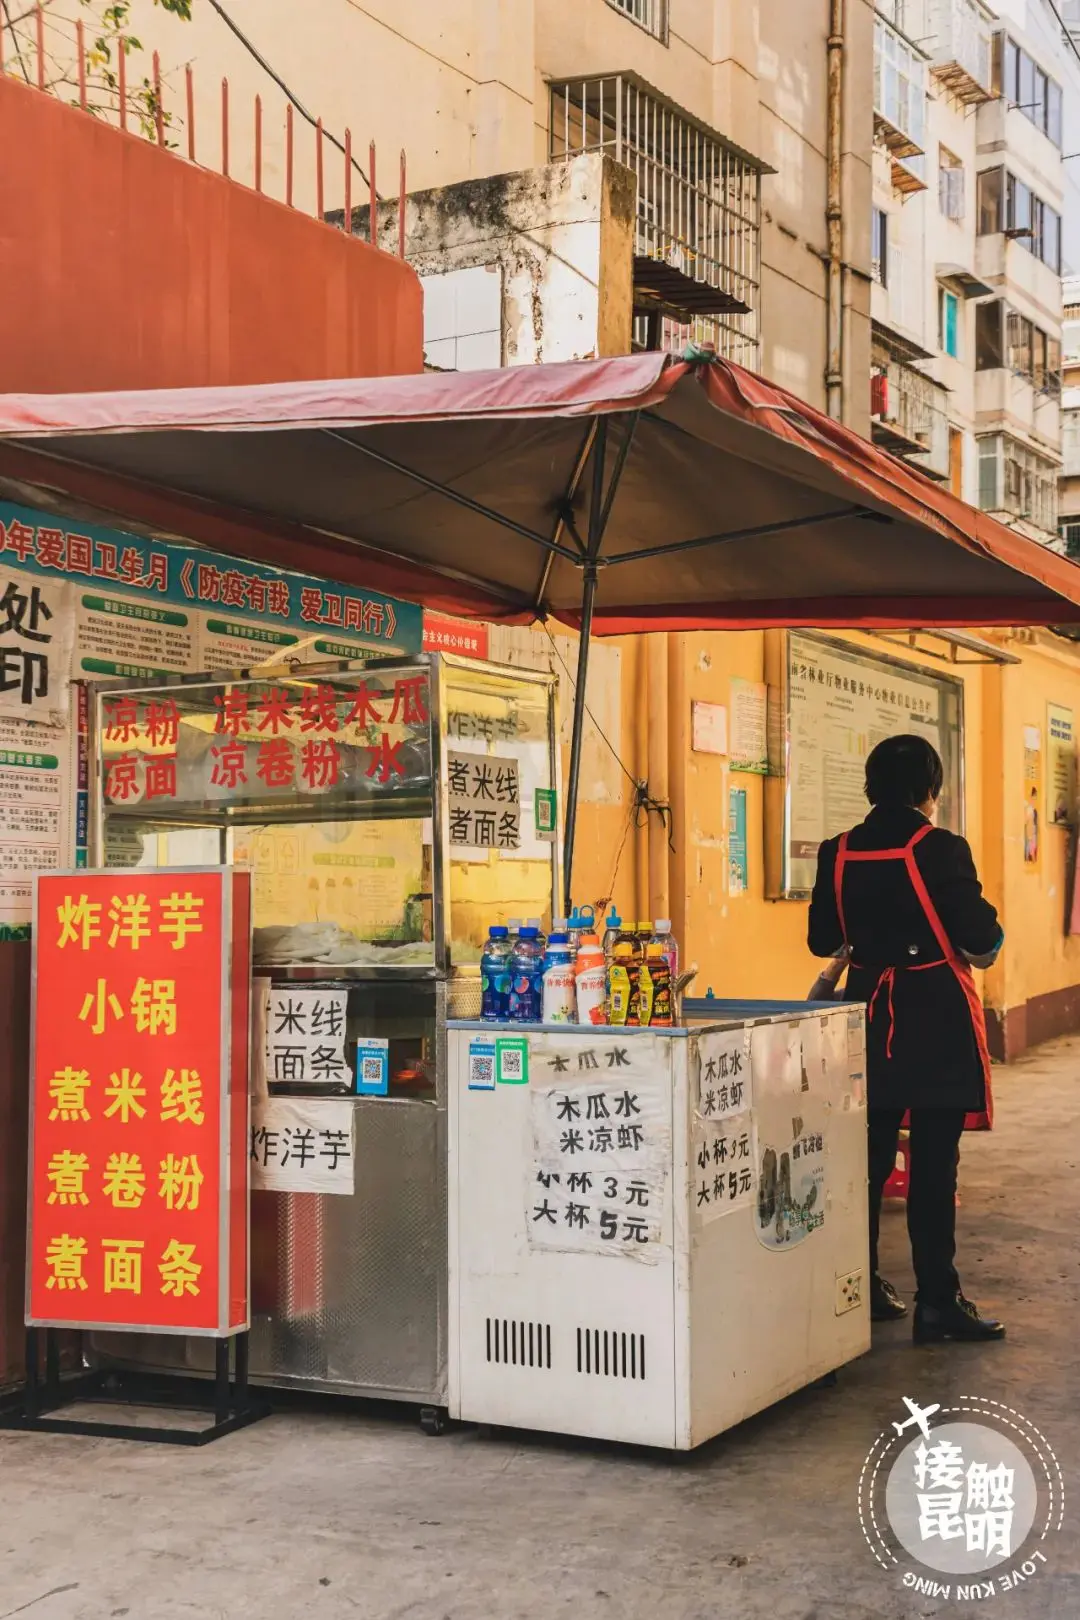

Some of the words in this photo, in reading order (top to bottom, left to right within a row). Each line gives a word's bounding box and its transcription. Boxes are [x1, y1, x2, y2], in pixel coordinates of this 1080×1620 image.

[0, 647, 49, 704] 印
[104, 696, 180, 747] 凉粉
[103, 752, 178, 800] 凉面
[210, 738, 341, 789] 凉卷粉
[364, 732, 406, 784] 水
[448, 759, 519, 804] 煮米线
[448, 806, 520, 848] 煮面条
[56, 892, 204, 951] 炸洋芋
[78, 976, 177, 1036] 小锅
[266, 998, 344, 1037] 米线
[266, 1044, 345, 1080] 面条
[704, 1049, 742, 1084] 木瓜水
[48, 1066, 205, 1125] 煮米线
[556, 1090, 642, 1122] 木瓜水
[703, 1081, 744, 1117] 米凉虾
[250, 1126, 351, 1170] 炸洋芋
[559, 1124, 645, 1155] 米凉虾
[46, 1149, 204, 1211] 煮卷粉
[45, 1234, 203, 1298] 煮面条
